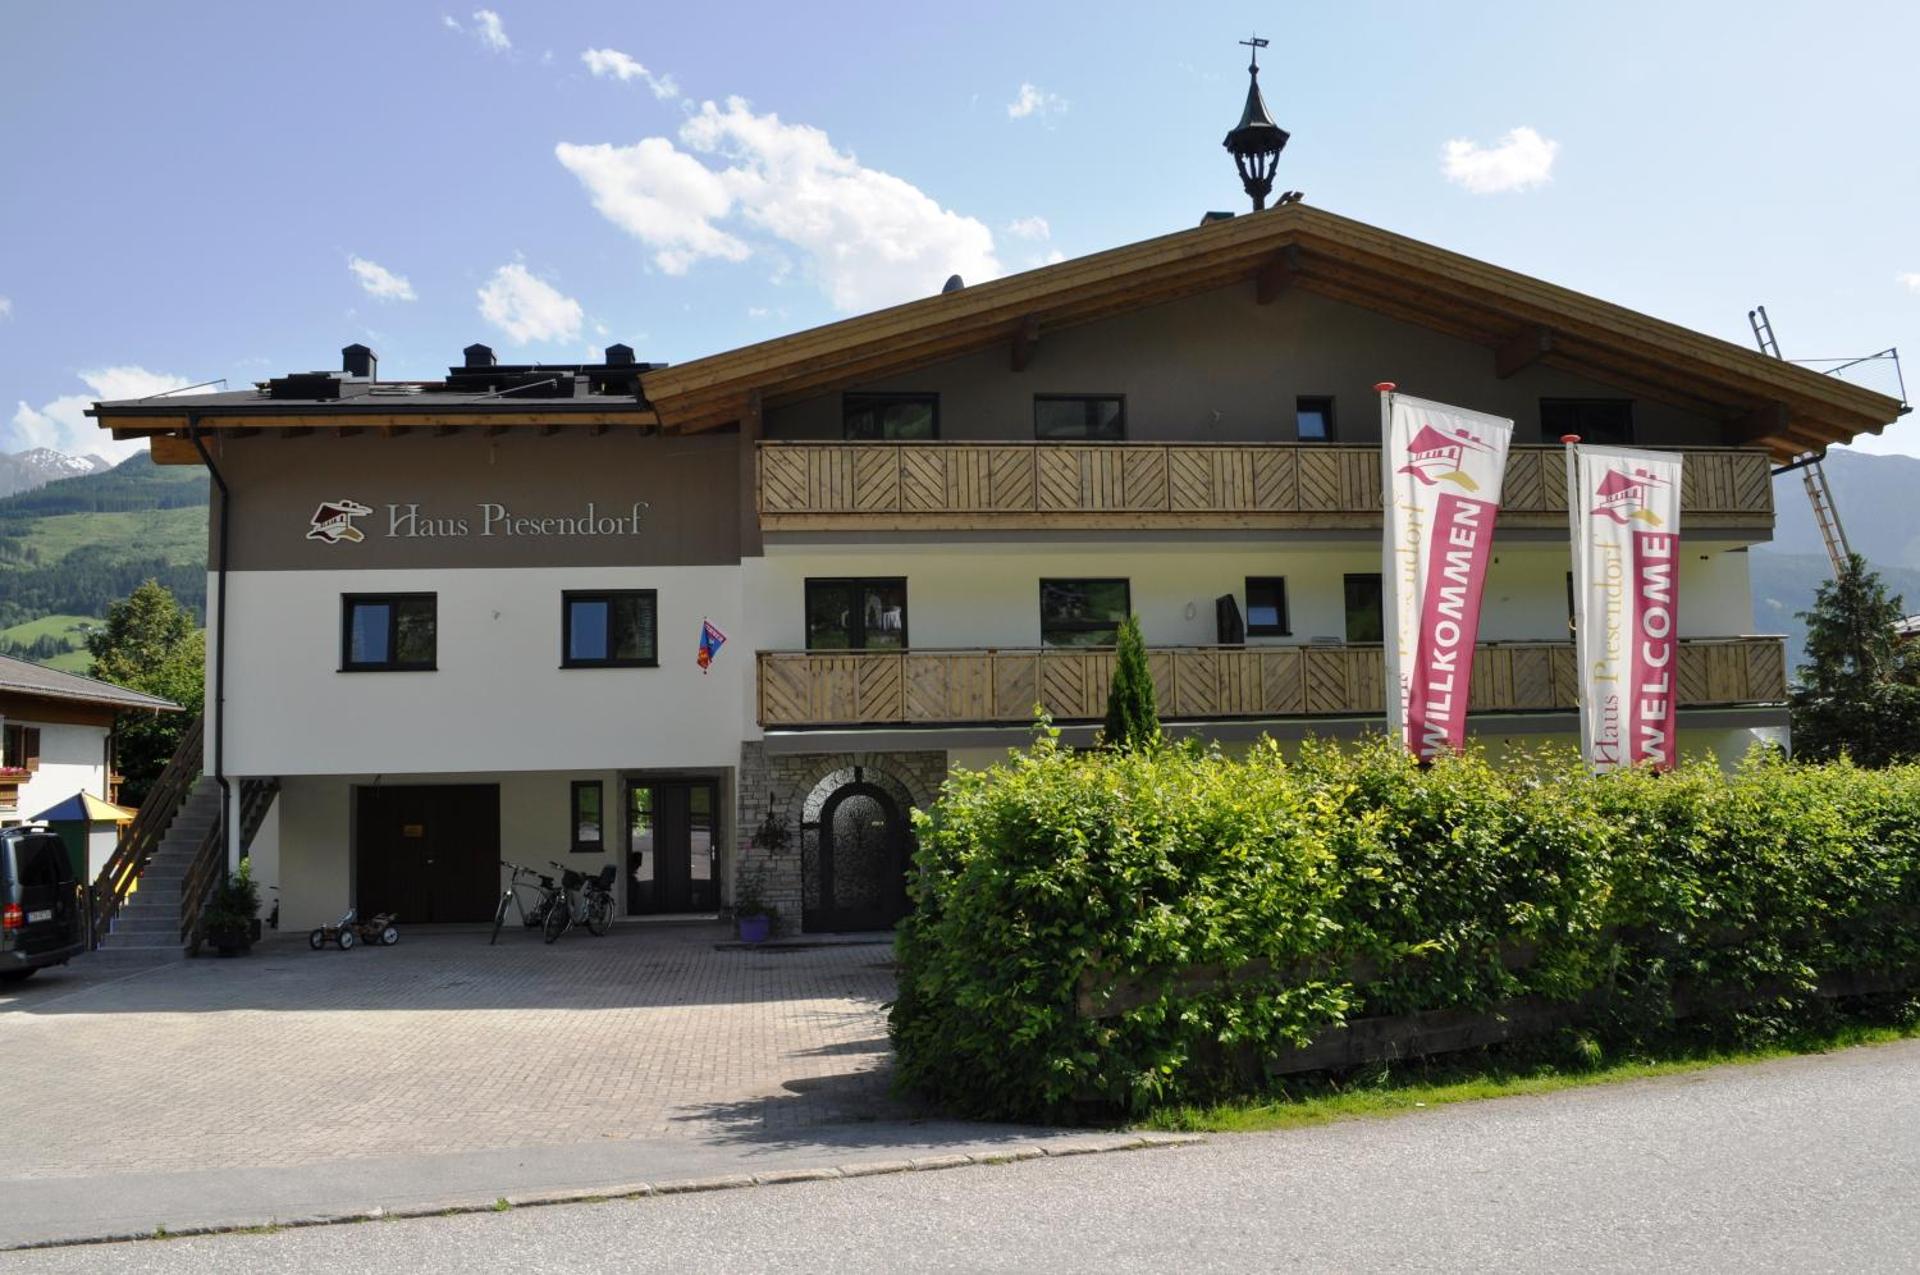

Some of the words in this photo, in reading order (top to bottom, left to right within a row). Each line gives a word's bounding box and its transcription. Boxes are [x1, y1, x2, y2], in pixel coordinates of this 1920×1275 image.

[385, 503, 468, 538] Haus
[478, 502, 650, 537] Piesendorf
[1421, 500, 1483, 757] WILLKOMMEN
[1640, 536, 1671, 765] WELCOME
[1595, 695, 1619, 766] Haus
